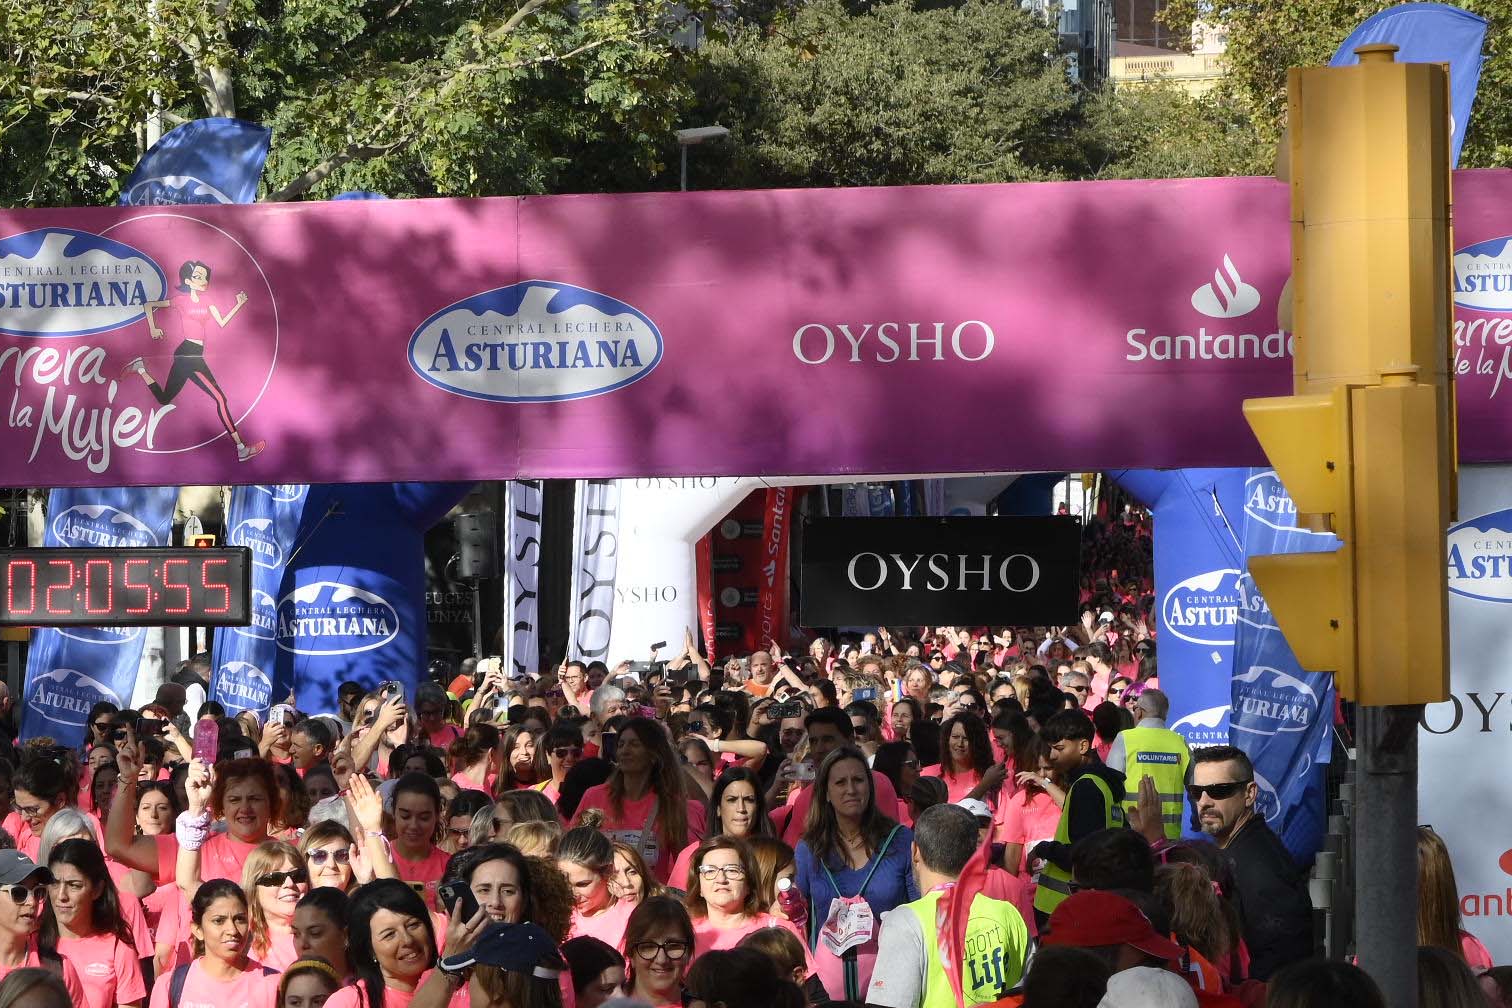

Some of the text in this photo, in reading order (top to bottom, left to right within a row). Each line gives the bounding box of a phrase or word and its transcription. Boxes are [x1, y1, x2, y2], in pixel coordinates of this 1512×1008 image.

[70, 264, 143, 276] LECHERA
[1466, 261, 1512, 272] CENTRA
[466, 321, 635, 336] CENTRAL LECHERA
[791, 319, 996, 365] OYSHO
[1453, 317, 1512, 347] arre
[427, 327, 643, 374] ASTURIANA
[1476, 348, 1494, 375] la
[8, 388, 33, 429] la
[28, 378, 178, 474] Mujer
[846, 551, 1042, 593] OYSHO
[7, 558, 231, 615] 02:05:55
[617, 585, 678, 605] YSHO
[1186, 595, 1236, 605] CENTRAL
[277, 610, 391, 638] ASTURIANA
[289, 606, 332, 615] CENTRAL
[1169, 597, 1238, 626] ASTUR
[1188, 731, 1229, 740] CENTRA
